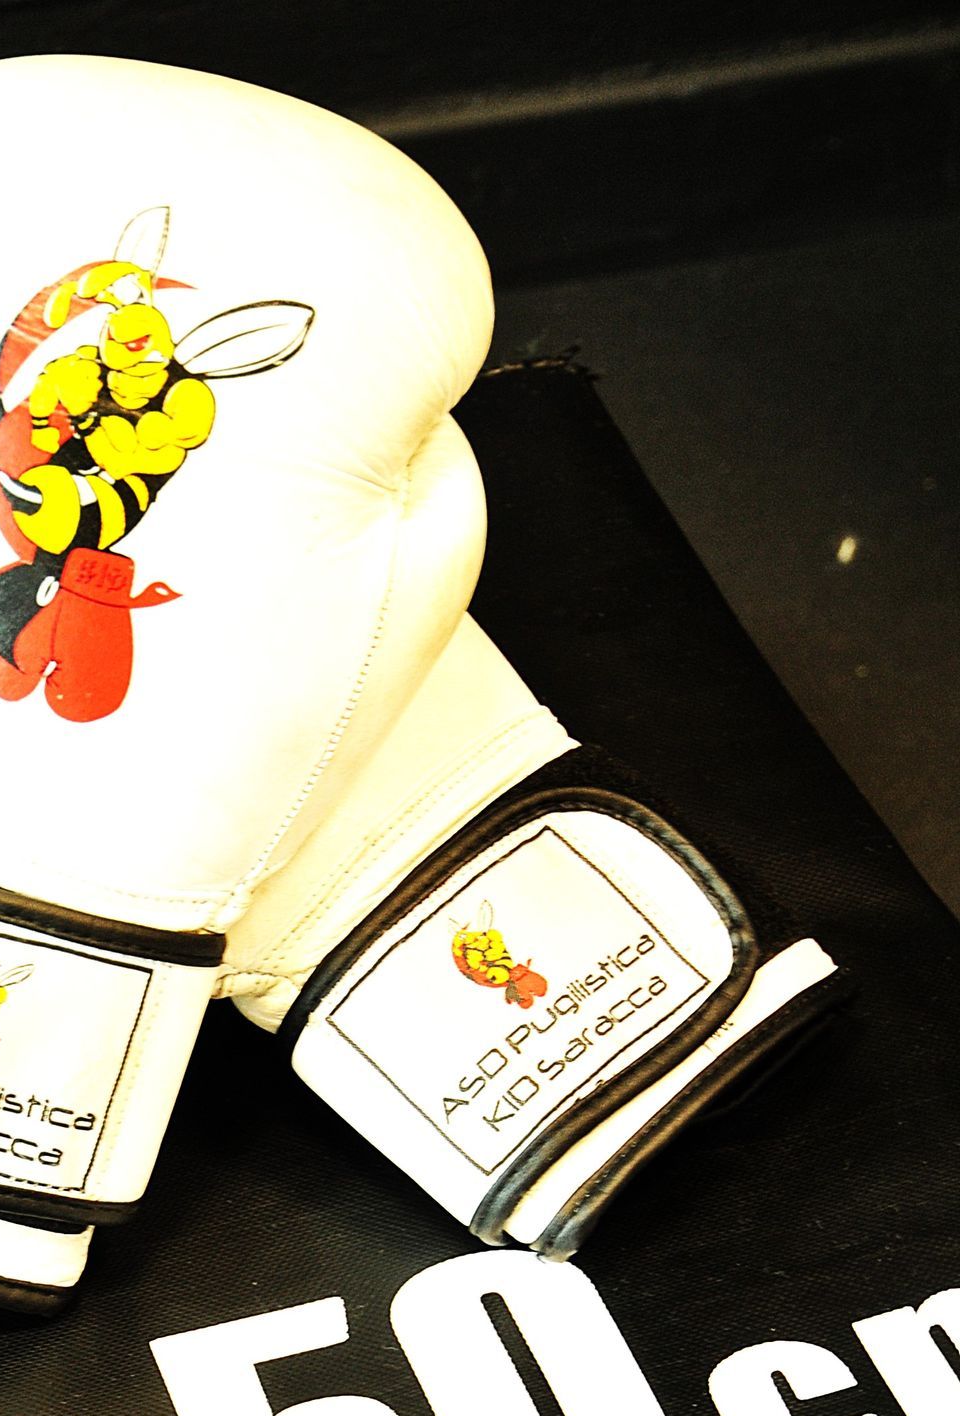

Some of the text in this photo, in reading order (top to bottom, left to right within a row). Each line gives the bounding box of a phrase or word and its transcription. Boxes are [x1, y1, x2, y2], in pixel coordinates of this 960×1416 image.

[442, 933, 657, 1124] ASD Pugilistica
[482, 975, 668, 1132] KID Saracca
